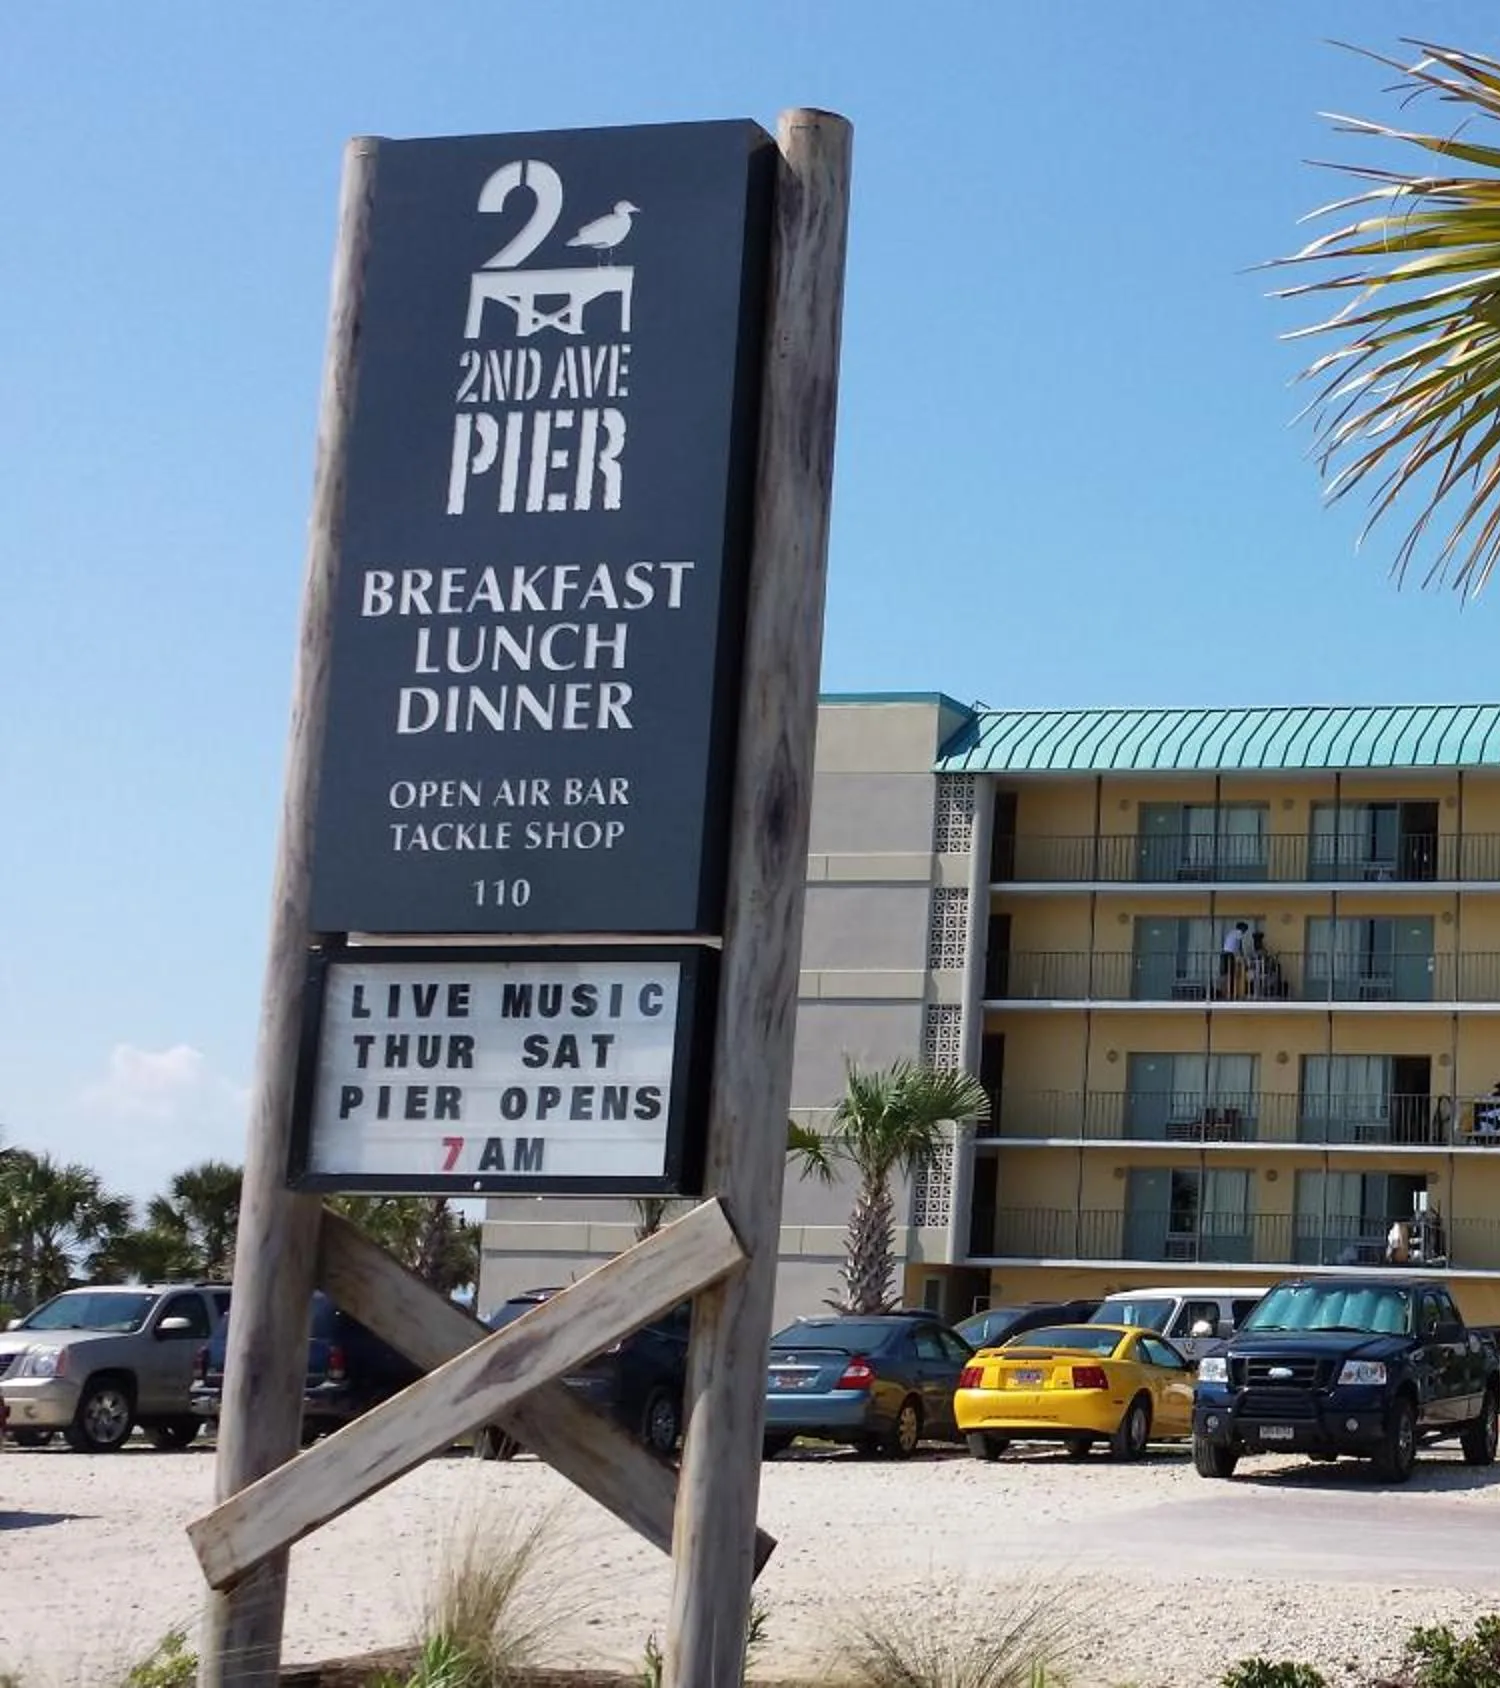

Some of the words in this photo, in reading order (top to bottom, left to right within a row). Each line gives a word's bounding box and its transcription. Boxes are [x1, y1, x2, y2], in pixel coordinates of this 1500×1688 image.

[477, 159, 563, 268] 2
[457, 348, 542, 403] 2ND
[550, 344, 631, 399] AVE
[447, 407, 627, 515] PIER
[362, 561, 695, 617] BREAKFAST
[415, 623, 627, 673] LUNCH
[397, 682, 633, 734] DINNER
[389, 781, 481, 809] OPEN
[493, 779, 550, 807] AIR
[563, 777, 629, 806] BAR
[390, 822, 511, 851] TACKLE
[525, 821, 625, 849] SHOP
[476, 879, 531, 907] 110
[351, 983, 471, 1019] LIVE
[501, 983, 663, 1019] MUSIC
[353, 1033, 475, 1069] THUR
[521, 1033, 615, 1069] SAT
[338, 1084, 462, 1121] PIER
[499, 1085, 662, 1121] OPENS
[442, 1136, 465, 1172] 7
[477, 1136, 545, 1172] AM
